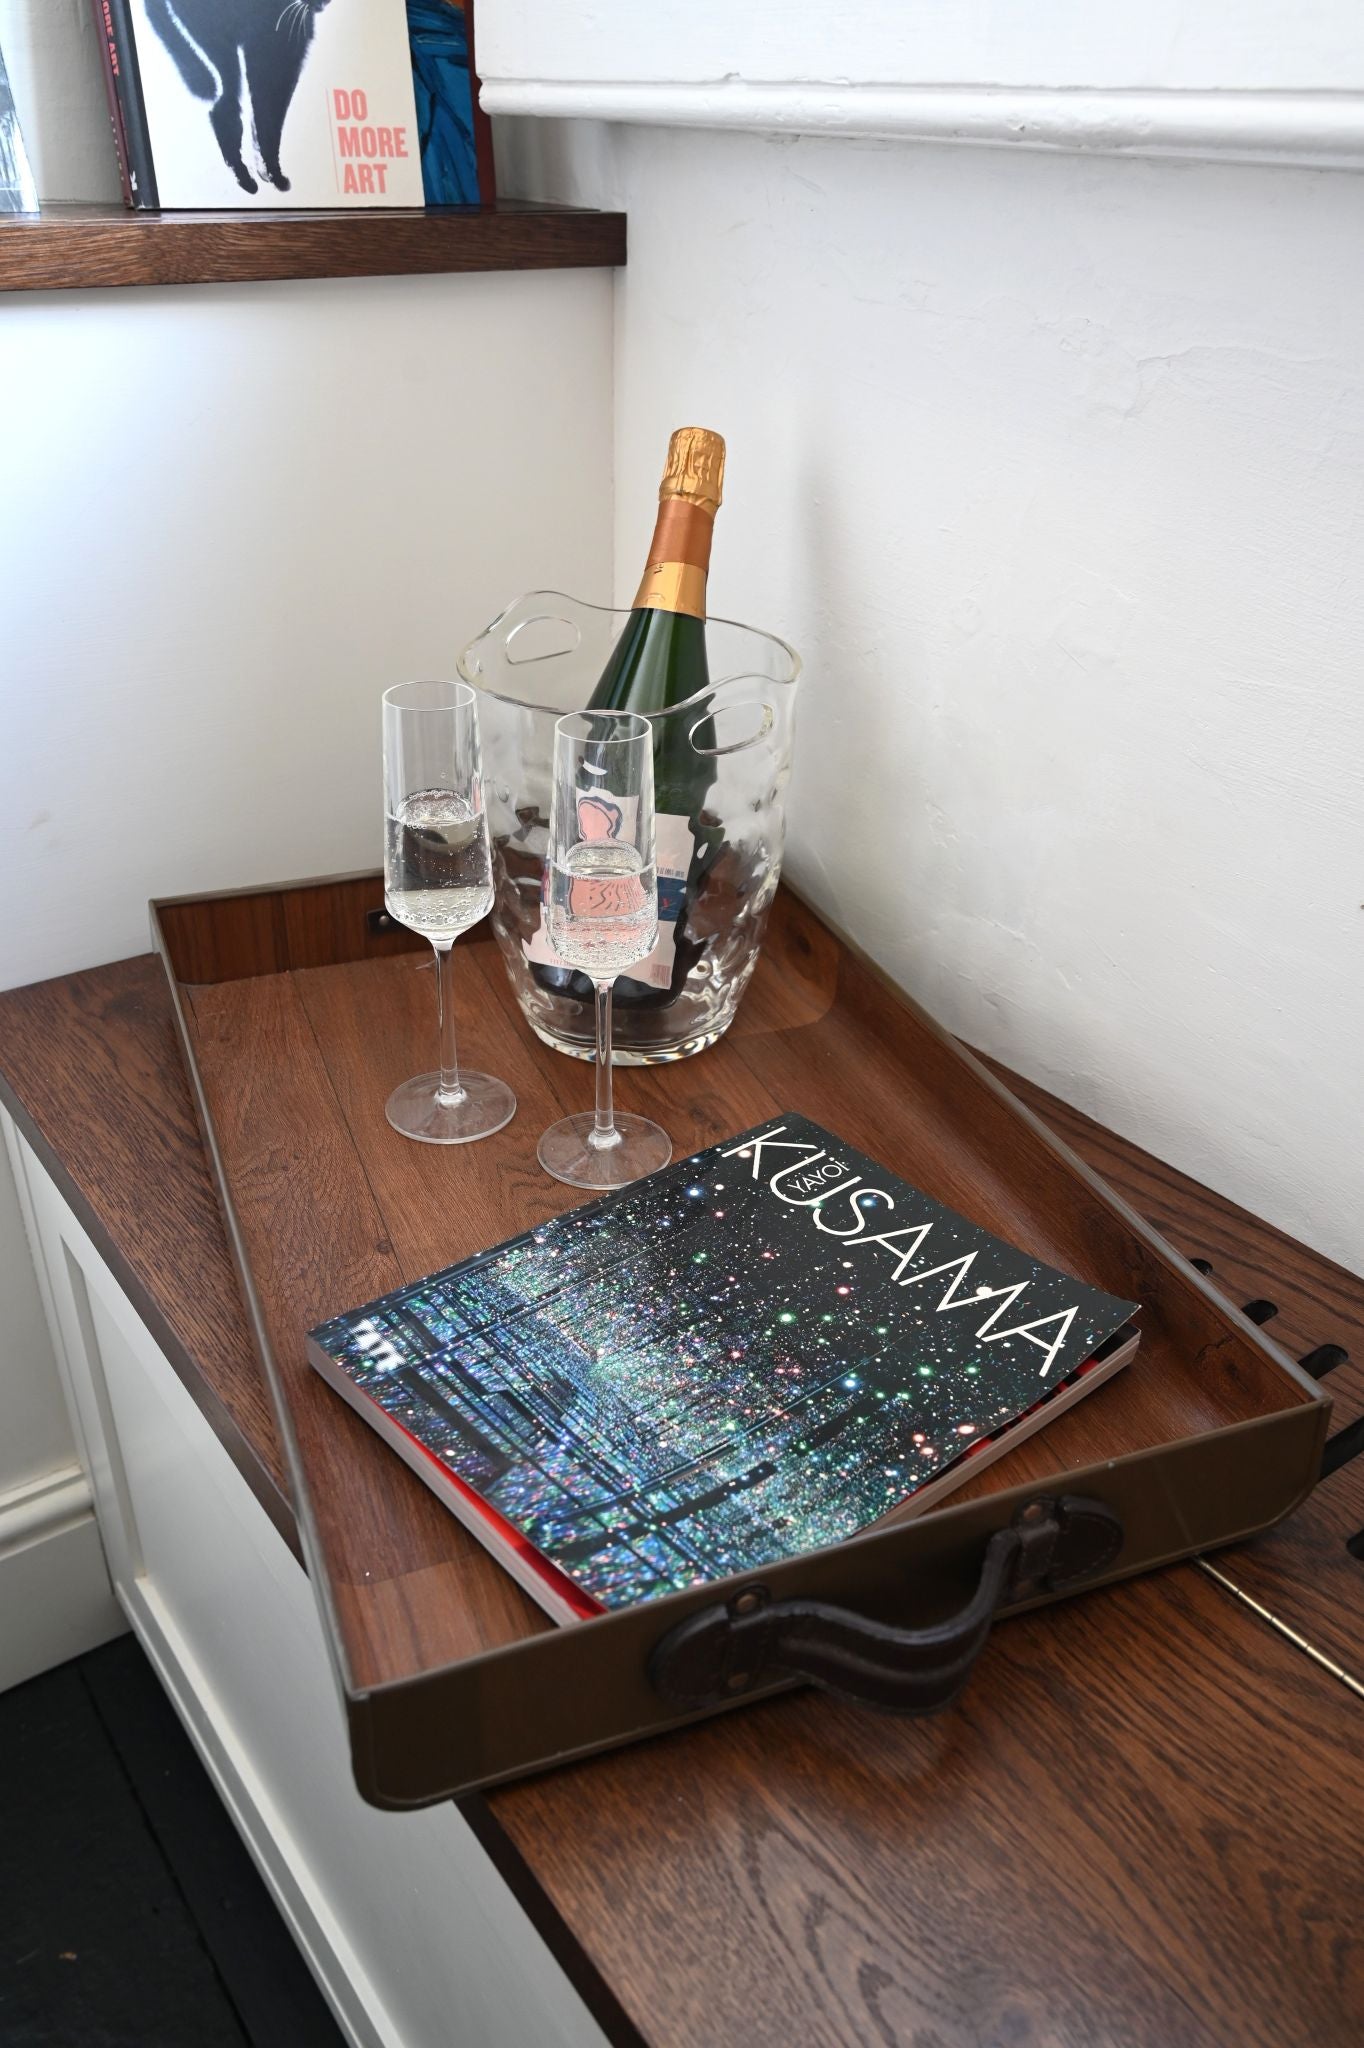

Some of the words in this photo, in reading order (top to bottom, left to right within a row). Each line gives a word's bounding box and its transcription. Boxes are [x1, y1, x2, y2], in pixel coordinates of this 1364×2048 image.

[102, 0, 114, 37] ORE
[108, 42, 120, 76] ART
[333, 88, 368, 121] DO
[337, 126, 409, 158] MORE
[343, 163, 388, 194] ART
[786, 1160, 850, 1193] YAYOI
[722, 1126, 1080, 1378] KUSAMA
[348, 1318, 408, 1374] TATE
